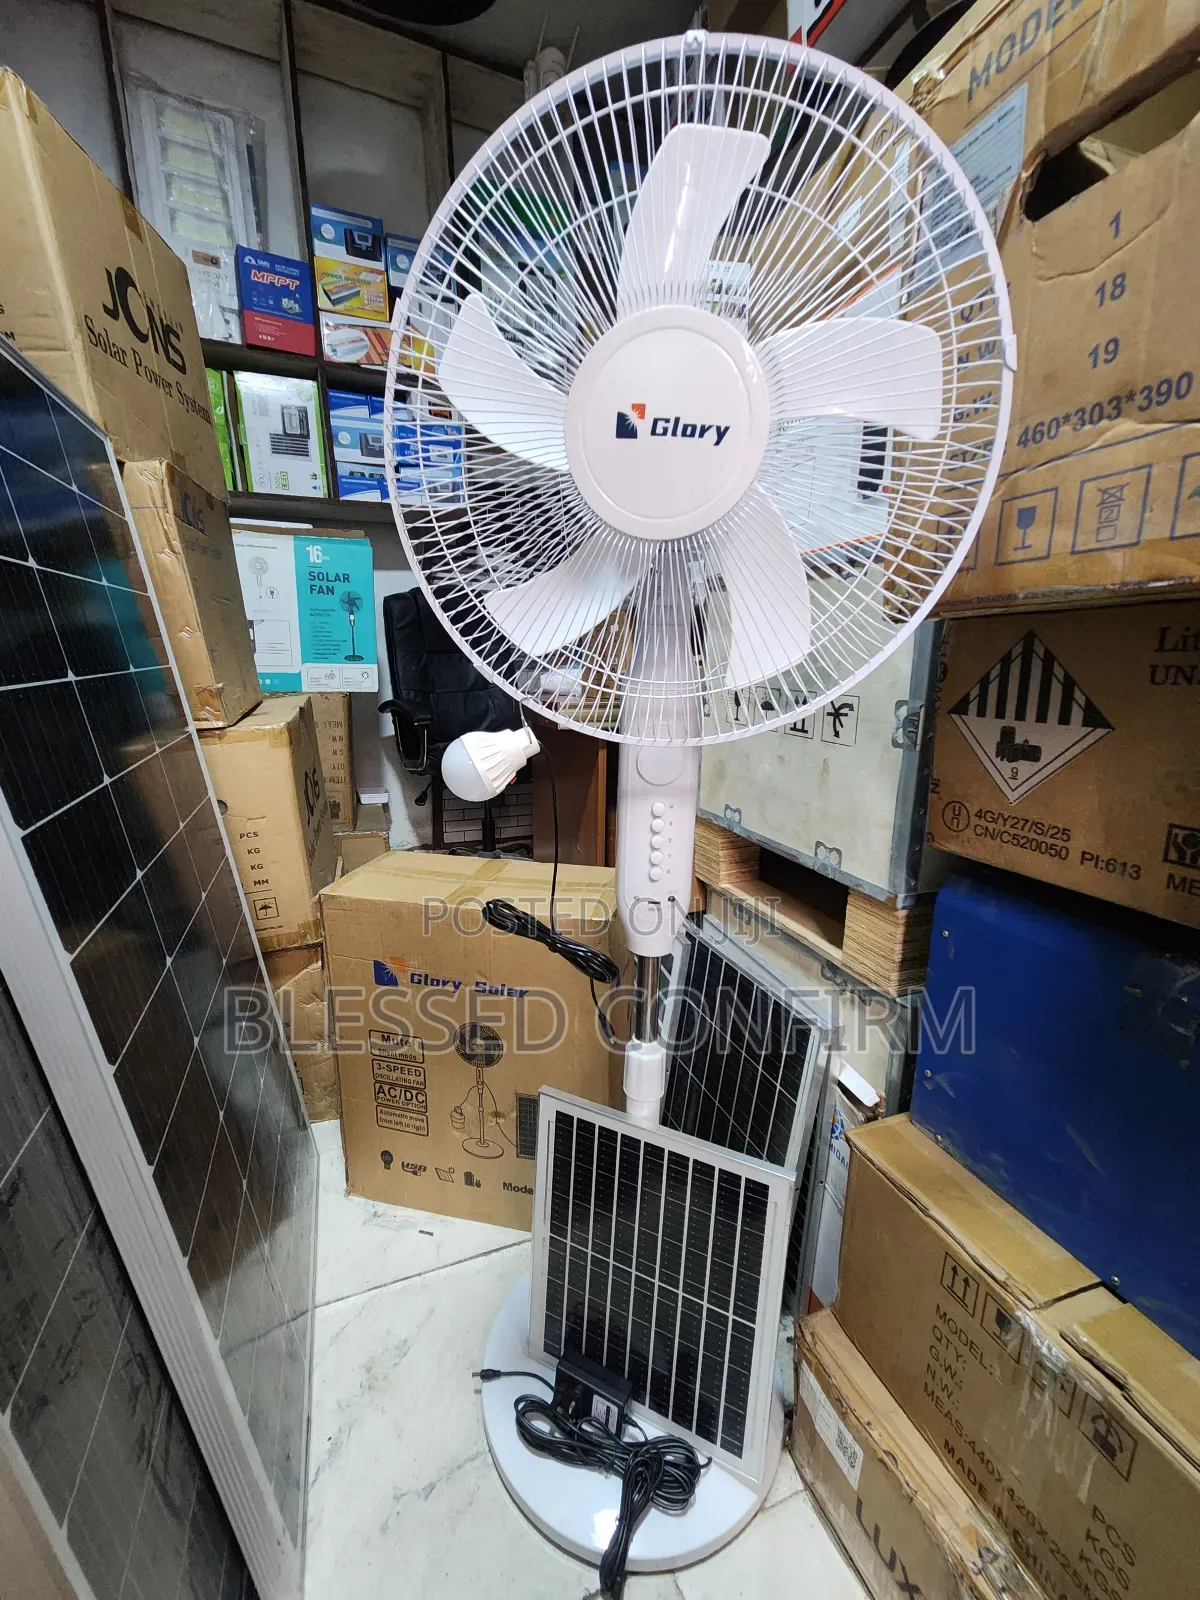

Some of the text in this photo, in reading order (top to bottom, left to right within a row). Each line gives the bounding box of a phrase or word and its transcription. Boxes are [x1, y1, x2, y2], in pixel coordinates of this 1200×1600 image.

[967, 0, 1087, 103] MODE
[1108, 210, 1122, 239] 1
[250, 269, 299, 290] MPPT
[1094, 271, 1127, 309] 18
[1087, 336, 1120, 370] 19
[85, 313, 212, 427] Solar Power System
[650, 416, 731, 446] Glory
[305, 544, 323, 564] 16
[308, 571, 351, 583] SOLAR
[309, 584, 335, 596] FAN
[1010, 766, 1020, 780] 9
[239, 831, 259, 840] PCS
[974, 808, 1072, 843] 4G/Y27/S/25
[247, 847, 261, 856] KG
[973, 824, 1143, 882] CN/C520050 PI:613
[250, 863, 264, 871] KG
[253, 878, 270, 887] MM
[409, 972, 530, 999] Glory Solar
[381, 1034, 411, 1048] Mute
[399, 1052, 417, 1061] mode
[375, 1072, 412, 1085] OSCILLATING
[376, 1062, 422, 1078] 3-SPEED
[376, 1084, 425, 1104] AC/DC
[376, 1095, 426, 1111] POWER OPTION
[379, 1108, 425, 1124] Automatic move
[379, 1117, 393, 1125] from
[394, 1119, 404, 1128] left
[411, 1122, 426, 1132] right
[401, 1160, 428, 1172] USB
[932, 1324, 967, 1372] QTY:
[935, 1303, 994, 1377] MODEL:
[944, 1437, 989, 1501] MADE
[1092, 1504, 1137, 1567] PCS
[1085, 1527, 1130, 1593] KGS
